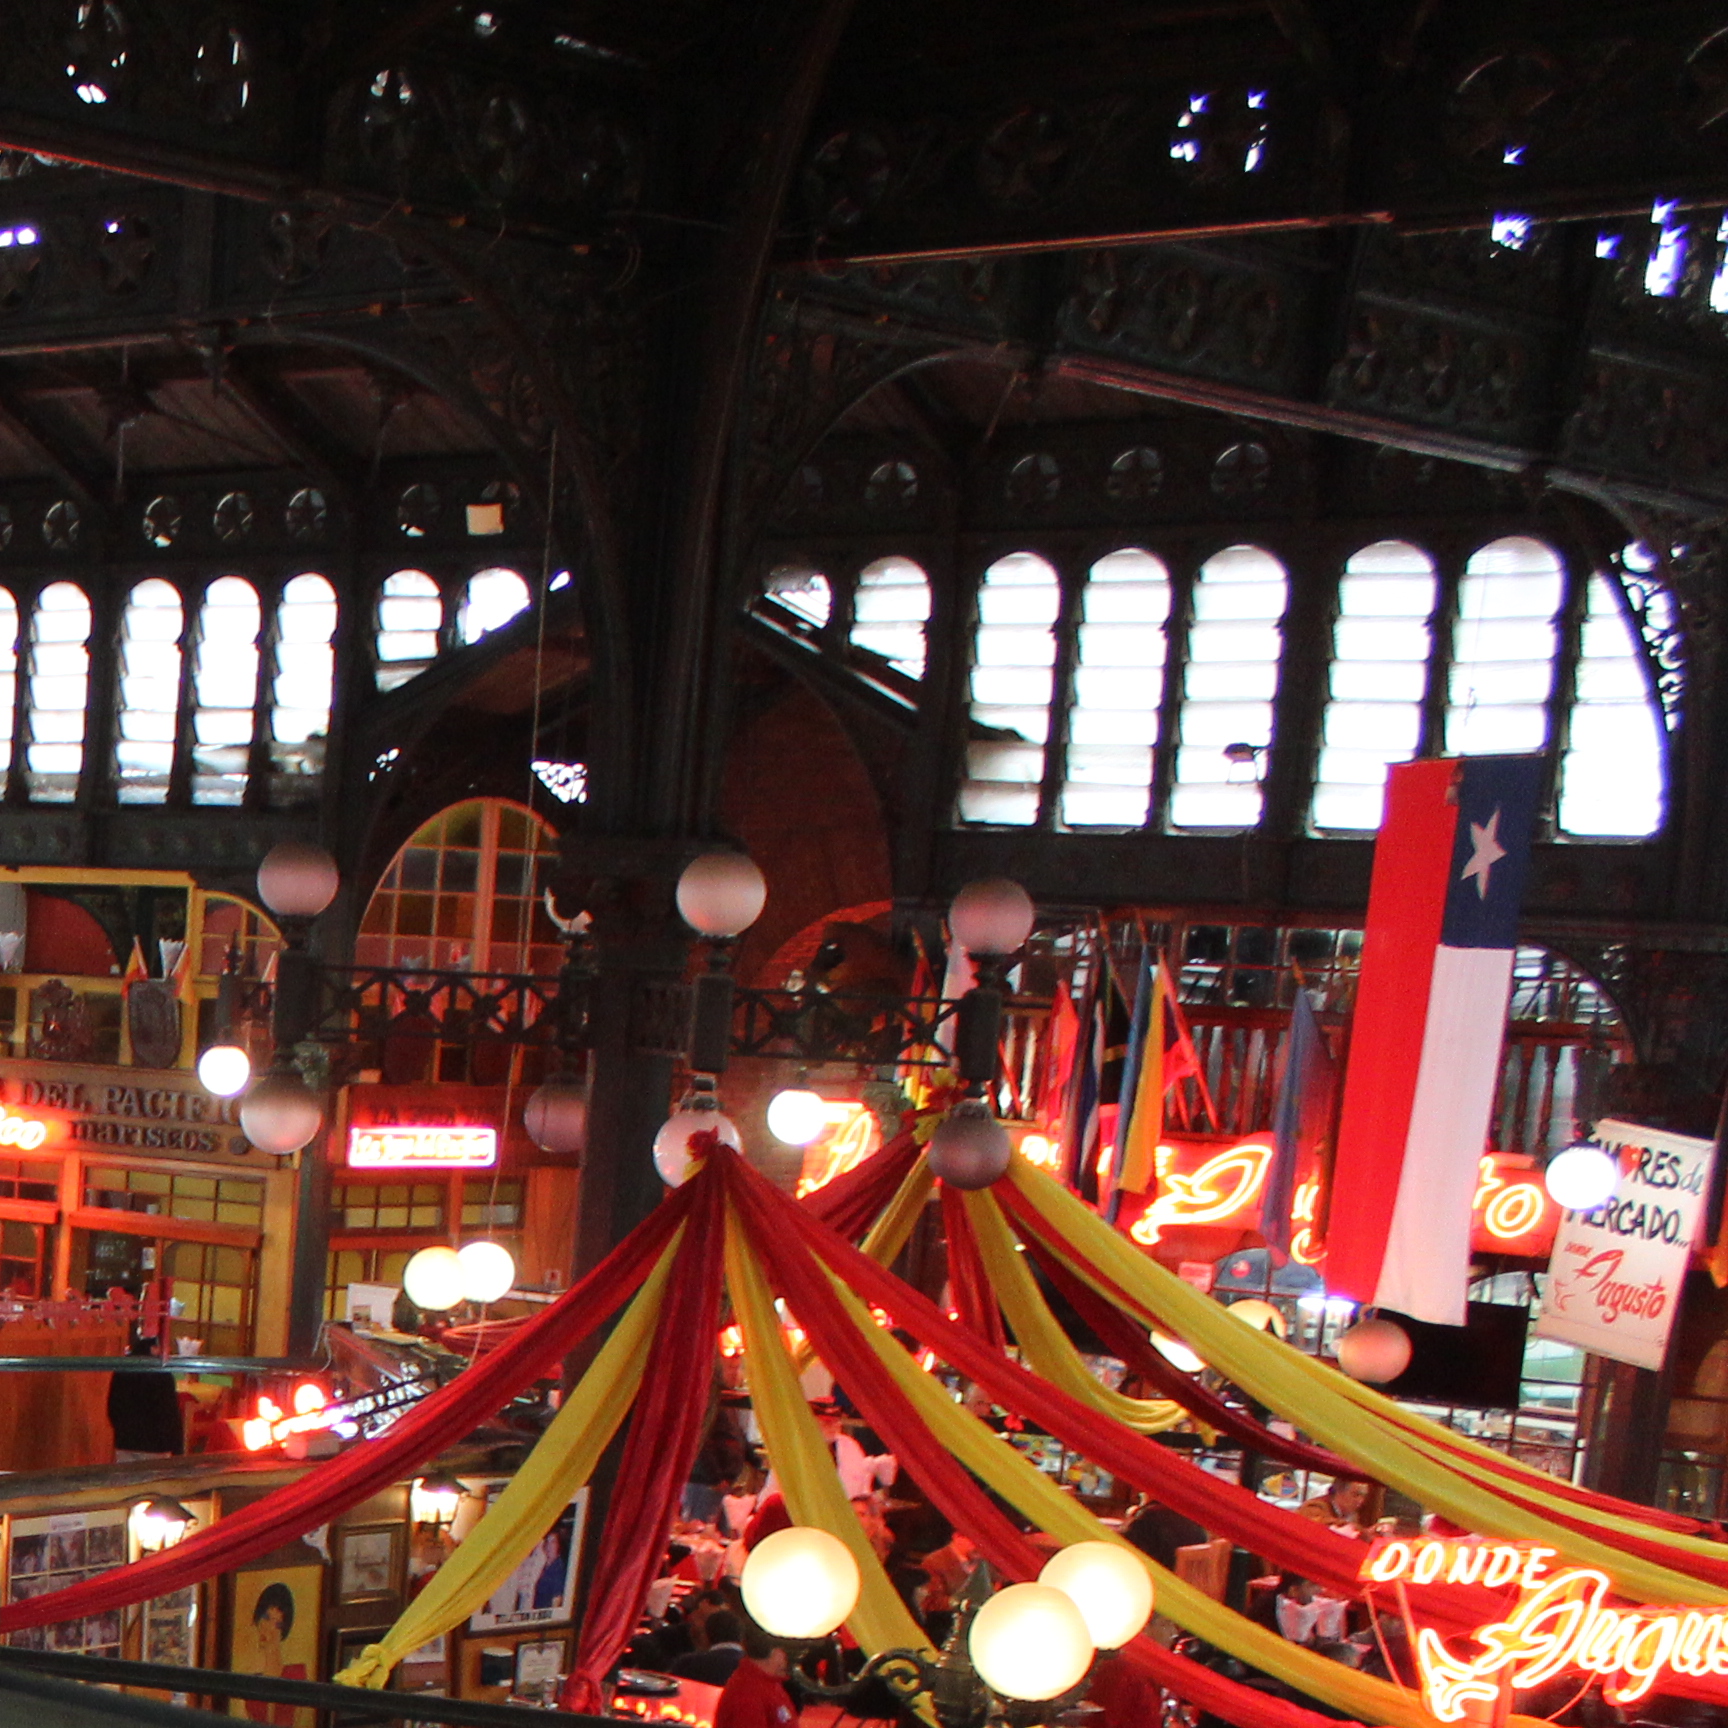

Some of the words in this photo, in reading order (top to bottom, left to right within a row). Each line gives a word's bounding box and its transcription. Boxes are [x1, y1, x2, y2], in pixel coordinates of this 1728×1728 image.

[21, 1082, 89, 1113] DEL
[70, 1120, 217, 1152] mariscos
[1571, 1249, 1667, 1323] Augusto
[1371, 1541, 1558, 1590] DONDE
